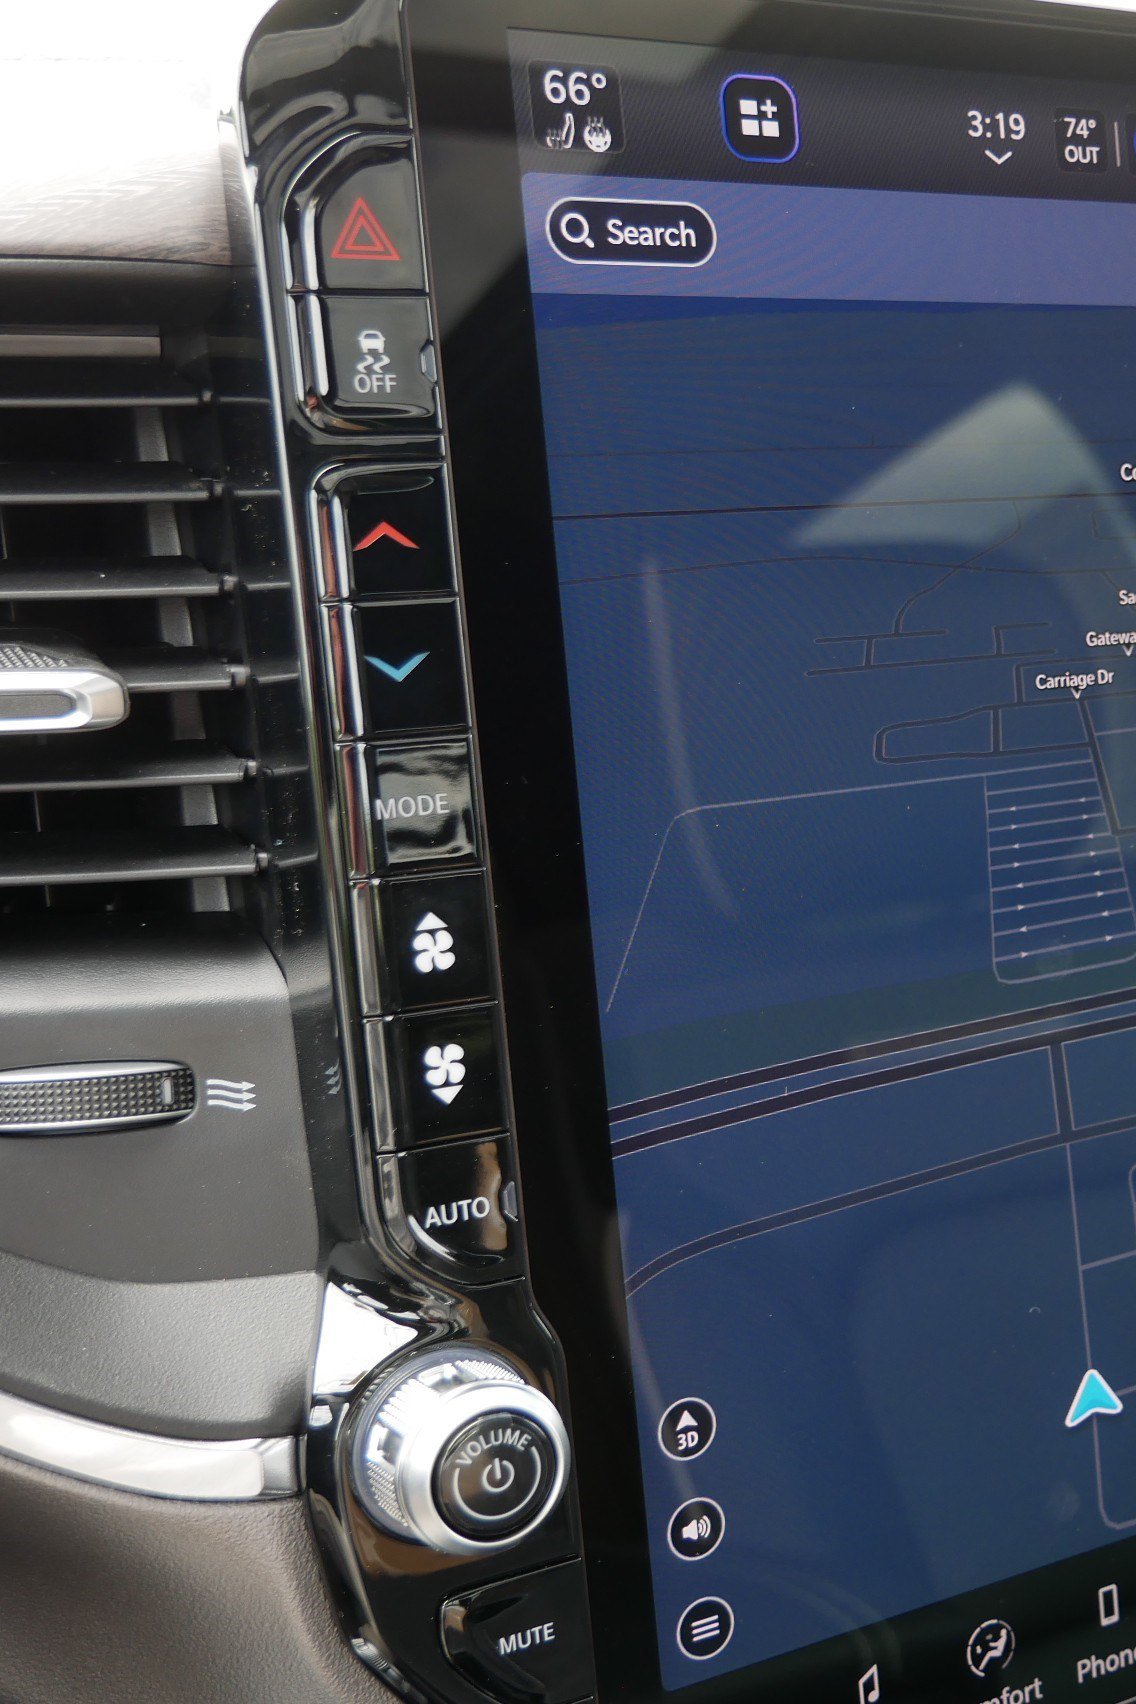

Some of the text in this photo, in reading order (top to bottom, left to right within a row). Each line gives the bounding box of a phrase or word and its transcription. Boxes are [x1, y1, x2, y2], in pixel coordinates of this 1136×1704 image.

[544, 69, 607, 106] 66°
[967, 111, 1026, 140] 3:19
[1063, 117, 1097, 138] 74°
[1064, 145, 1100, 164] OUT
[606, 219, 697, 249] Search
[354, 375, 397, 394] OFF
[1035, 670, 1115, 691] Carriage Dr
[375, 793, 450, 820] MODE
[425, 1197, 490, 1228] AUTO
[455, 1428, 533, 1467] VOLUME
[677, 1431, 700, 1450] 3D
[498, 1622, 556, 1656] MUTE
